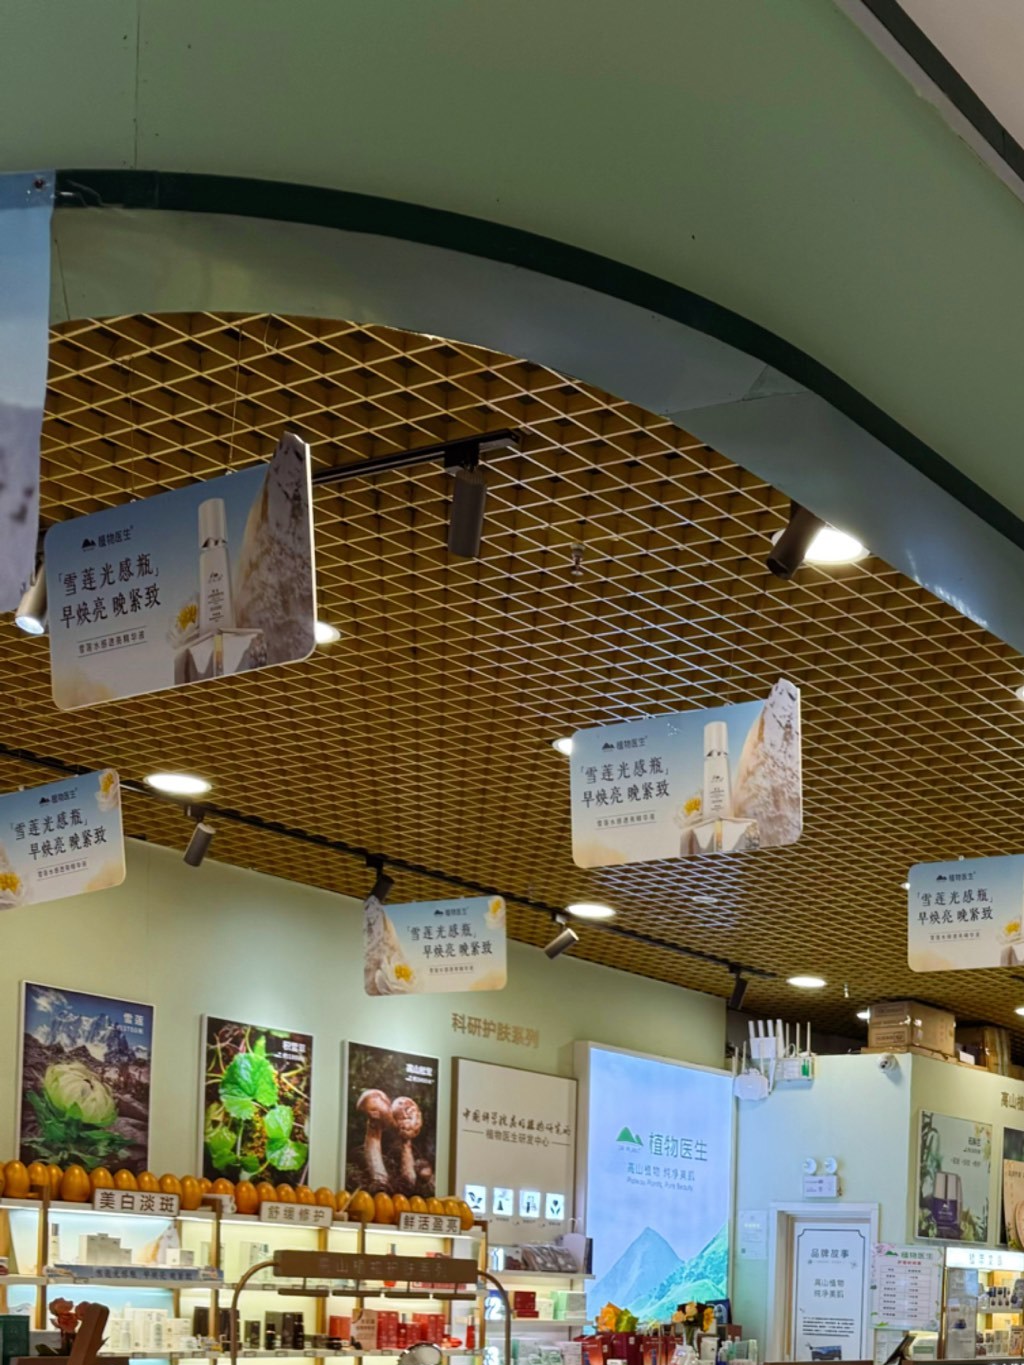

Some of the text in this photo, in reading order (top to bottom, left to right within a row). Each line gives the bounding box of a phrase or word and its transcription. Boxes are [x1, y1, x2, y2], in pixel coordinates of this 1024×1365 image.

[60, 583, 161, 629] 早焕亮 晚紧致
[451, 1013, 540, 1049] 科研护肤系列
[649, 1132, 708, 1162] 植物医生
[99, 1191, 175, 1213] 美白淡斑
